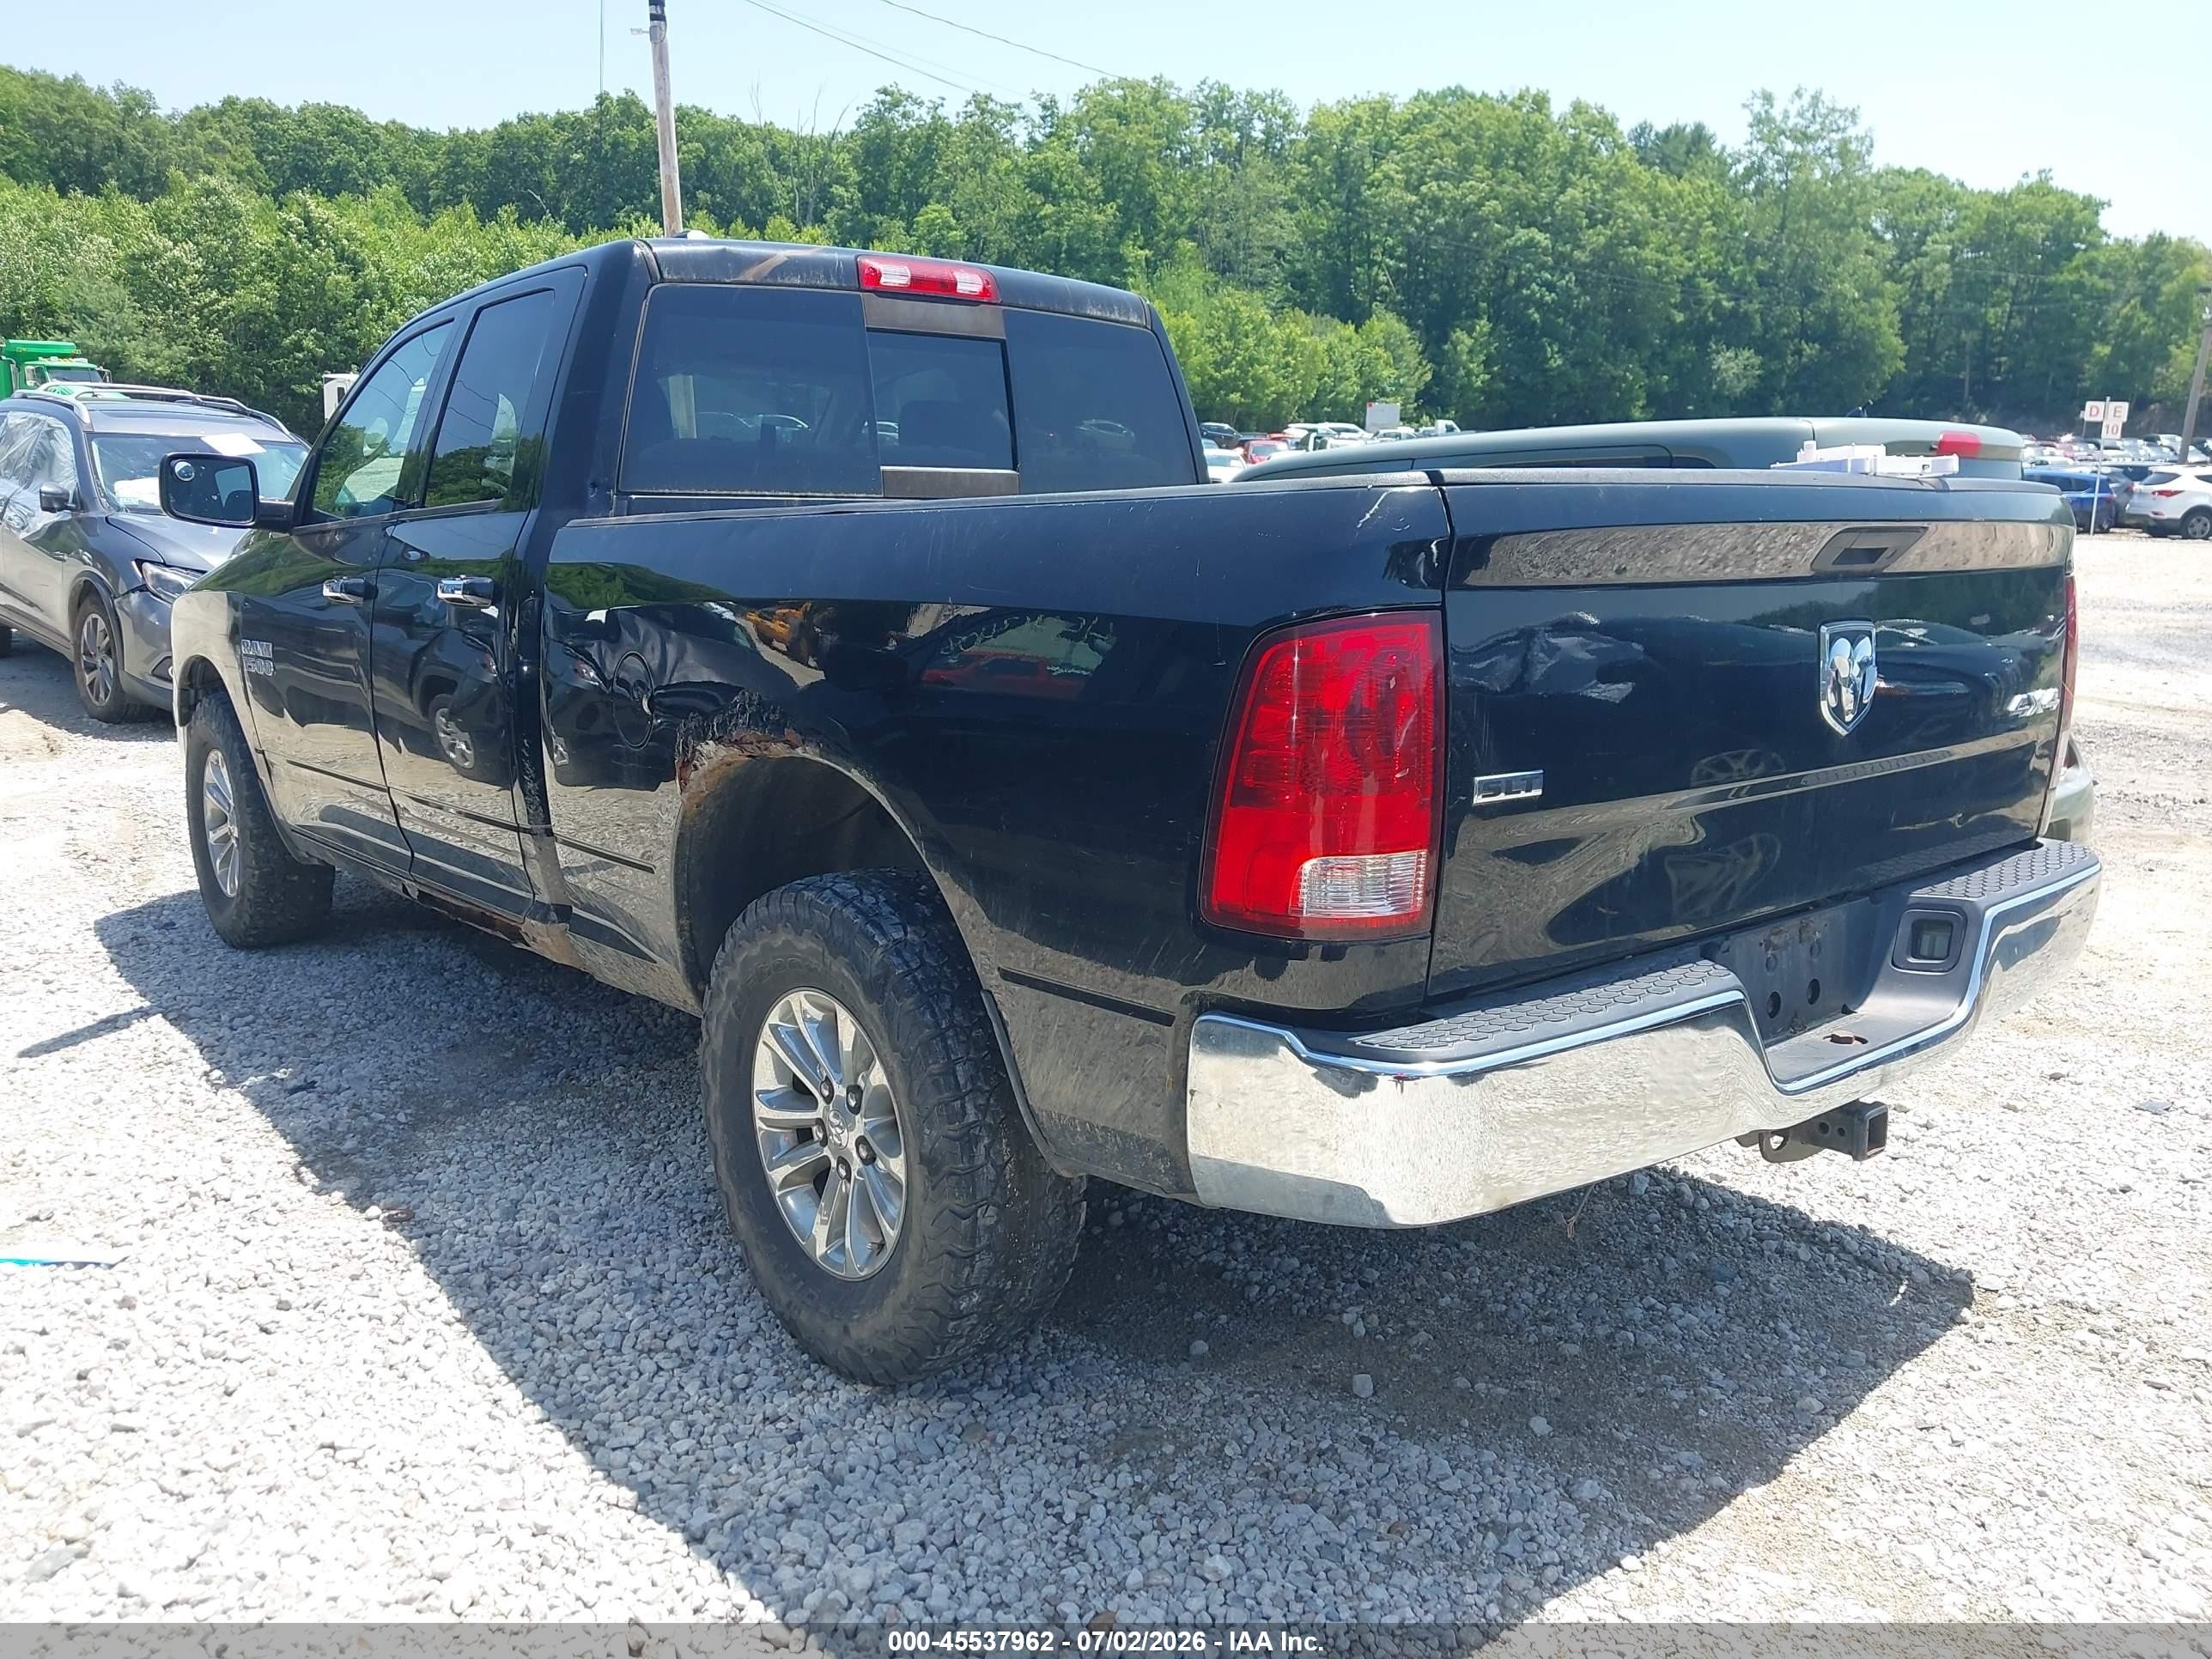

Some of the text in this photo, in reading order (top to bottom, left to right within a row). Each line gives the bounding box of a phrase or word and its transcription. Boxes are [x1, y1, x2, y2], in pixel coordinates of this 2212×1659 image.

[2089, 404, 2100, 417] D
[2113, 405, 2123, 417] E
[2105, 424, 2118, 434] 10
[240, 639, 273, 659] RAM
[242, 656, 275, 677] 1500
[1477, 773, 1542, 799] SLT
